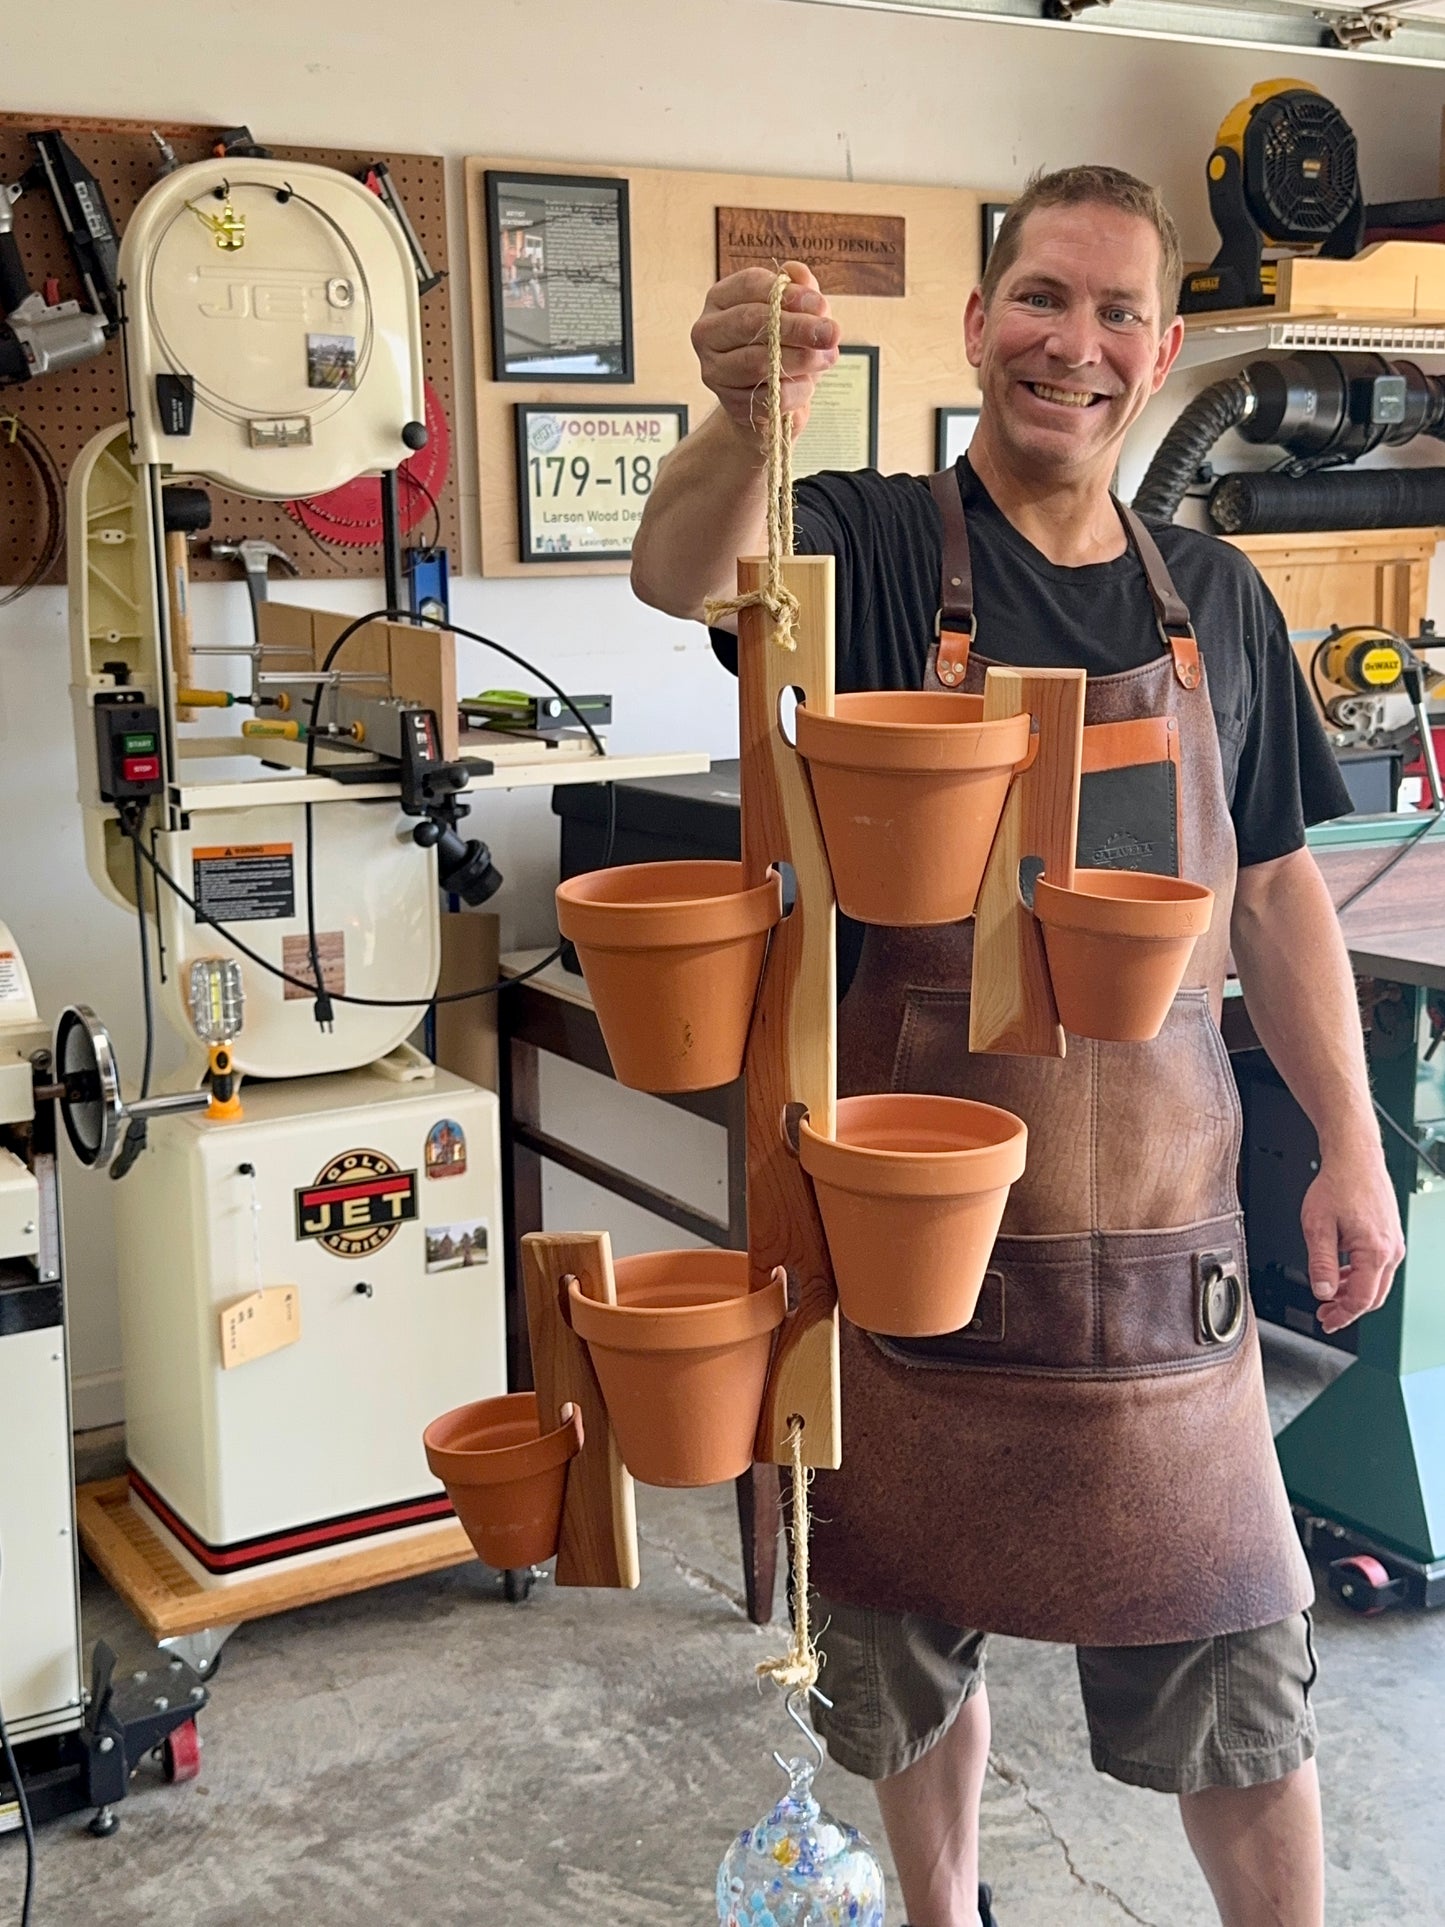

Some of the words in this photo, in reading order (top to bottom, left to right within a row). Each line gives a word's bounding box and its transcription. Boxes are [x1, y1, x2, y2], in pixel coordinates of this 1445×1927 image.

[728, 232, 784, 249] LARSON
[789, 236, 834, 251] WOOD
[838, 238, 897, 254] DESIGNS
[530, 455, 663, 498] 179-18
[543, 511, 585, 524] Larson
[587, 510, 619, 522] Wood
[414, 716, 431, 761] JET
[134, 765, 152, 773] STOP
[327, 1156, 389, 1181] GOLD
[304, 1190, 411, 1232] JET
[329, 1227, 390, 1252] SERIES
